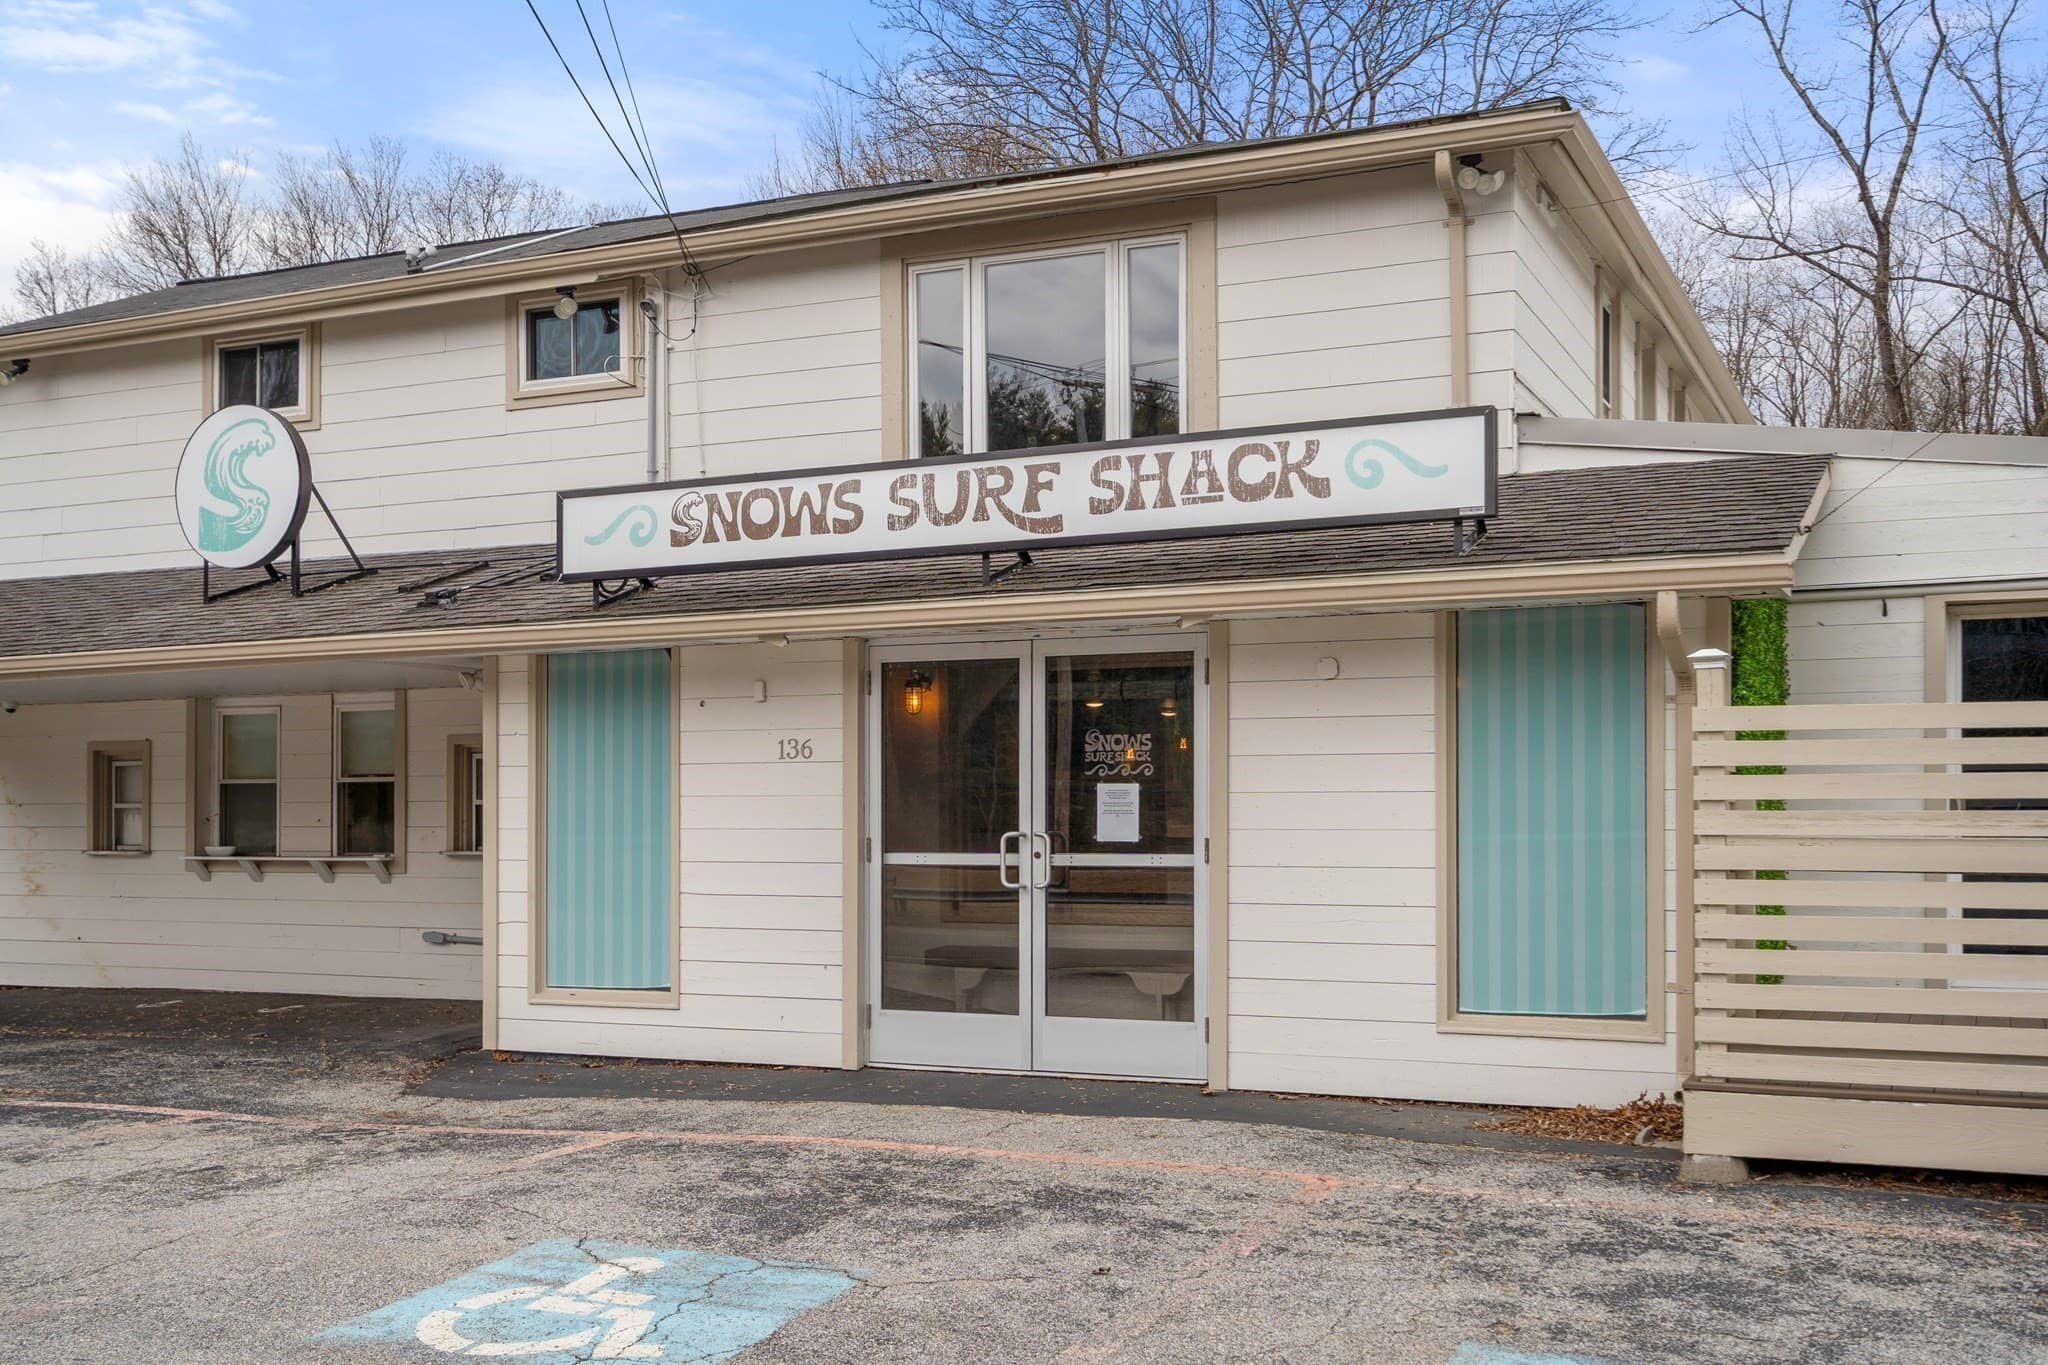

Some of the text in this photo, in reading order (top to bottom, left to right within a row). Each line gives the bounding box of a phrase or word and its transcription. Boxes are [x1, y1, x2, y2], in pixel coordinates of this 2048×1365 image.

[670, 439, 1331, 548] SNOWS SURF SHACK
[777, 738, 813, 760] 136
[1084, 728, 1152, 751] SNOWS
[1084, 751, 1152, 763] SURF SHCK
